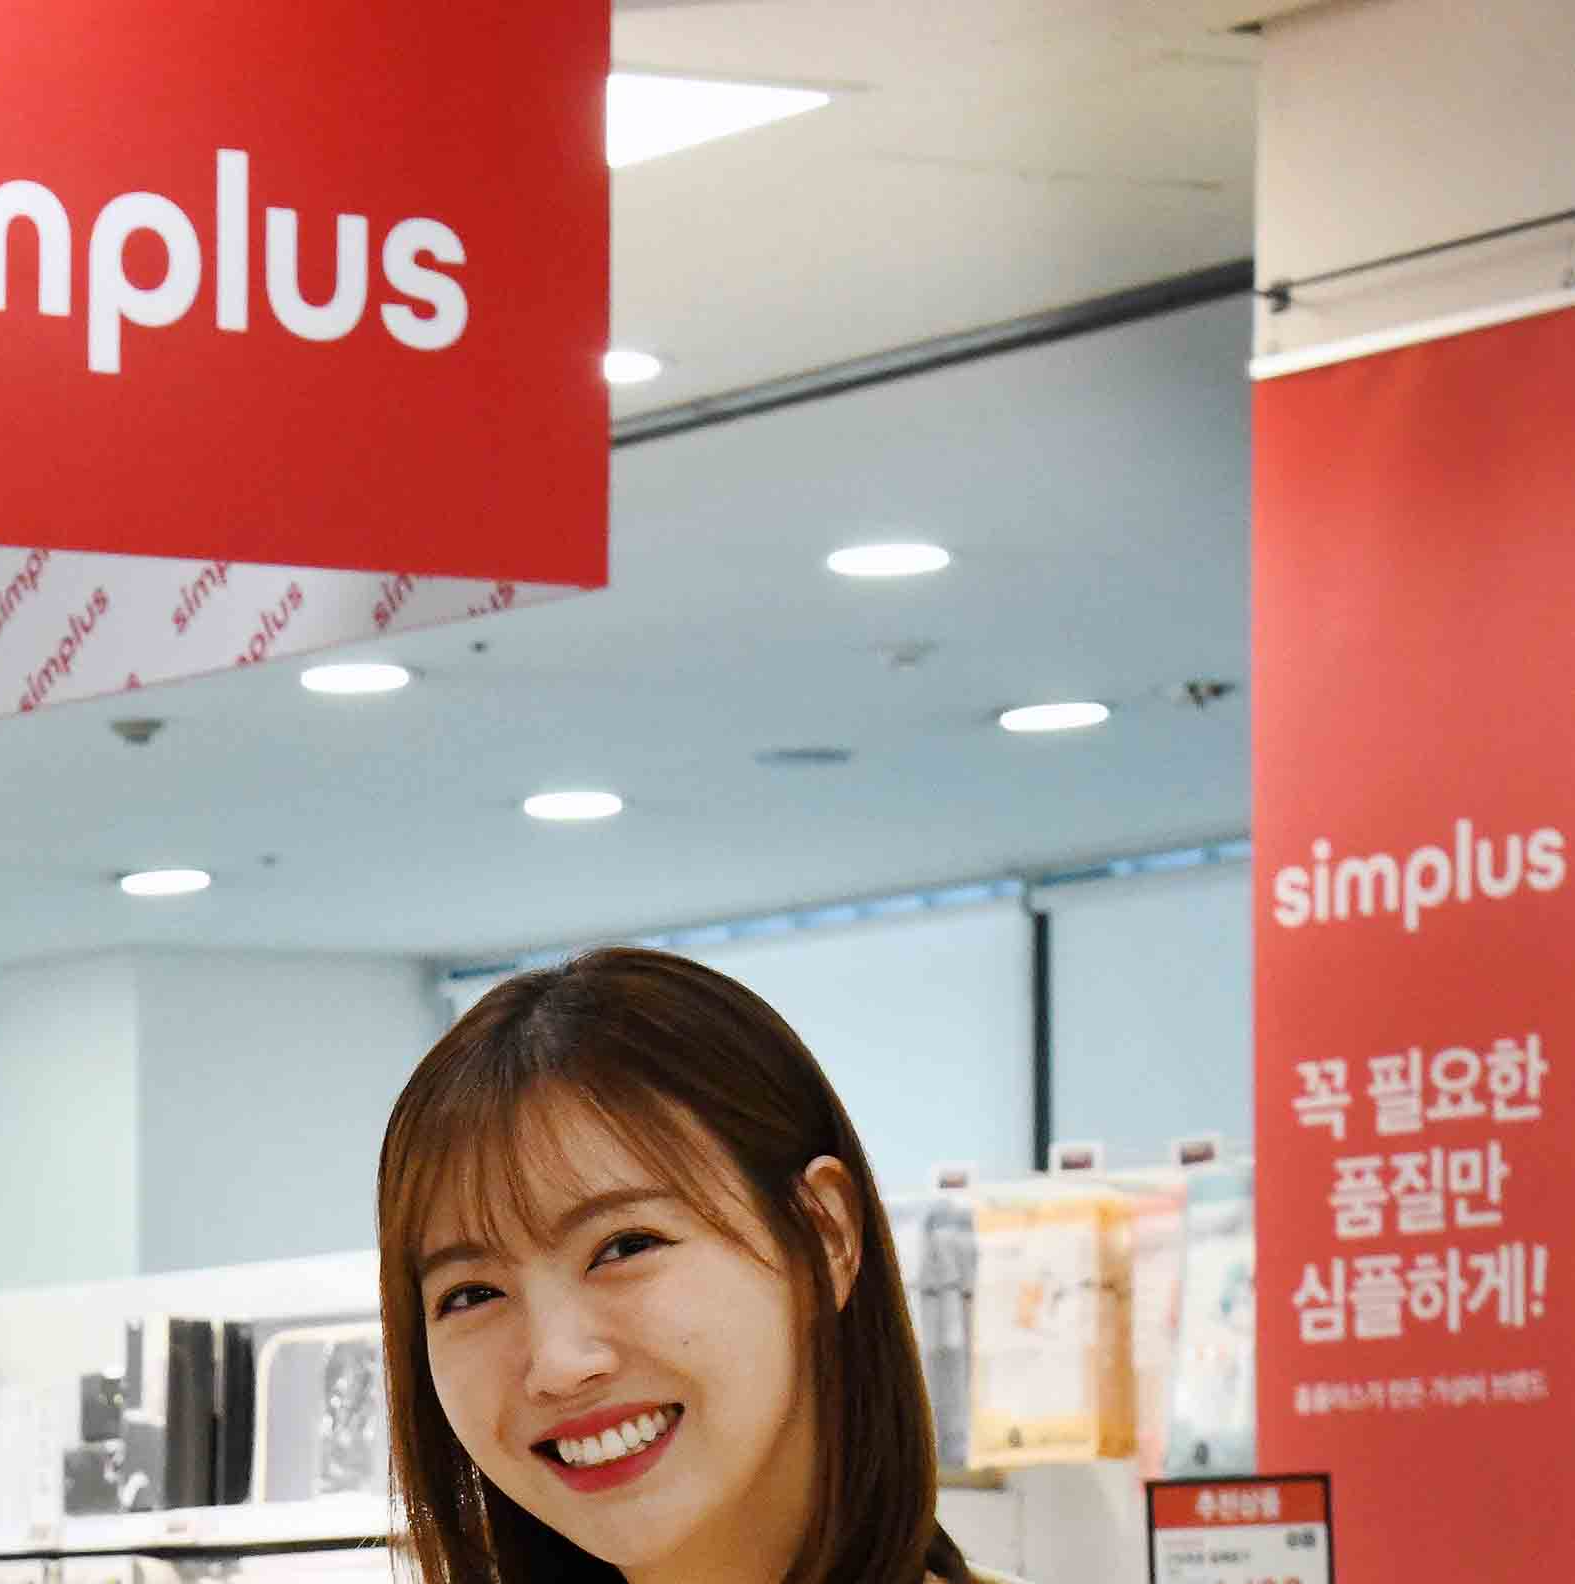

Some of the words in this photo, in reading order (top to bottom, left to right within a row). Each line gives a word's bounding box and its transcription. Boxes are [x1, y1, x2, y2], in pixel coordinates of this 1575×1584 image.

[1273, 817, 1567, 933] simplus
[1292, 1057, 1351, 1139] 꼭
[1366, 1033, 1549, 1136] 필요한
[1328, 1140, 1511, 1241] 품질만
[1292, 1242, 1549, 1345] 심플하게!
